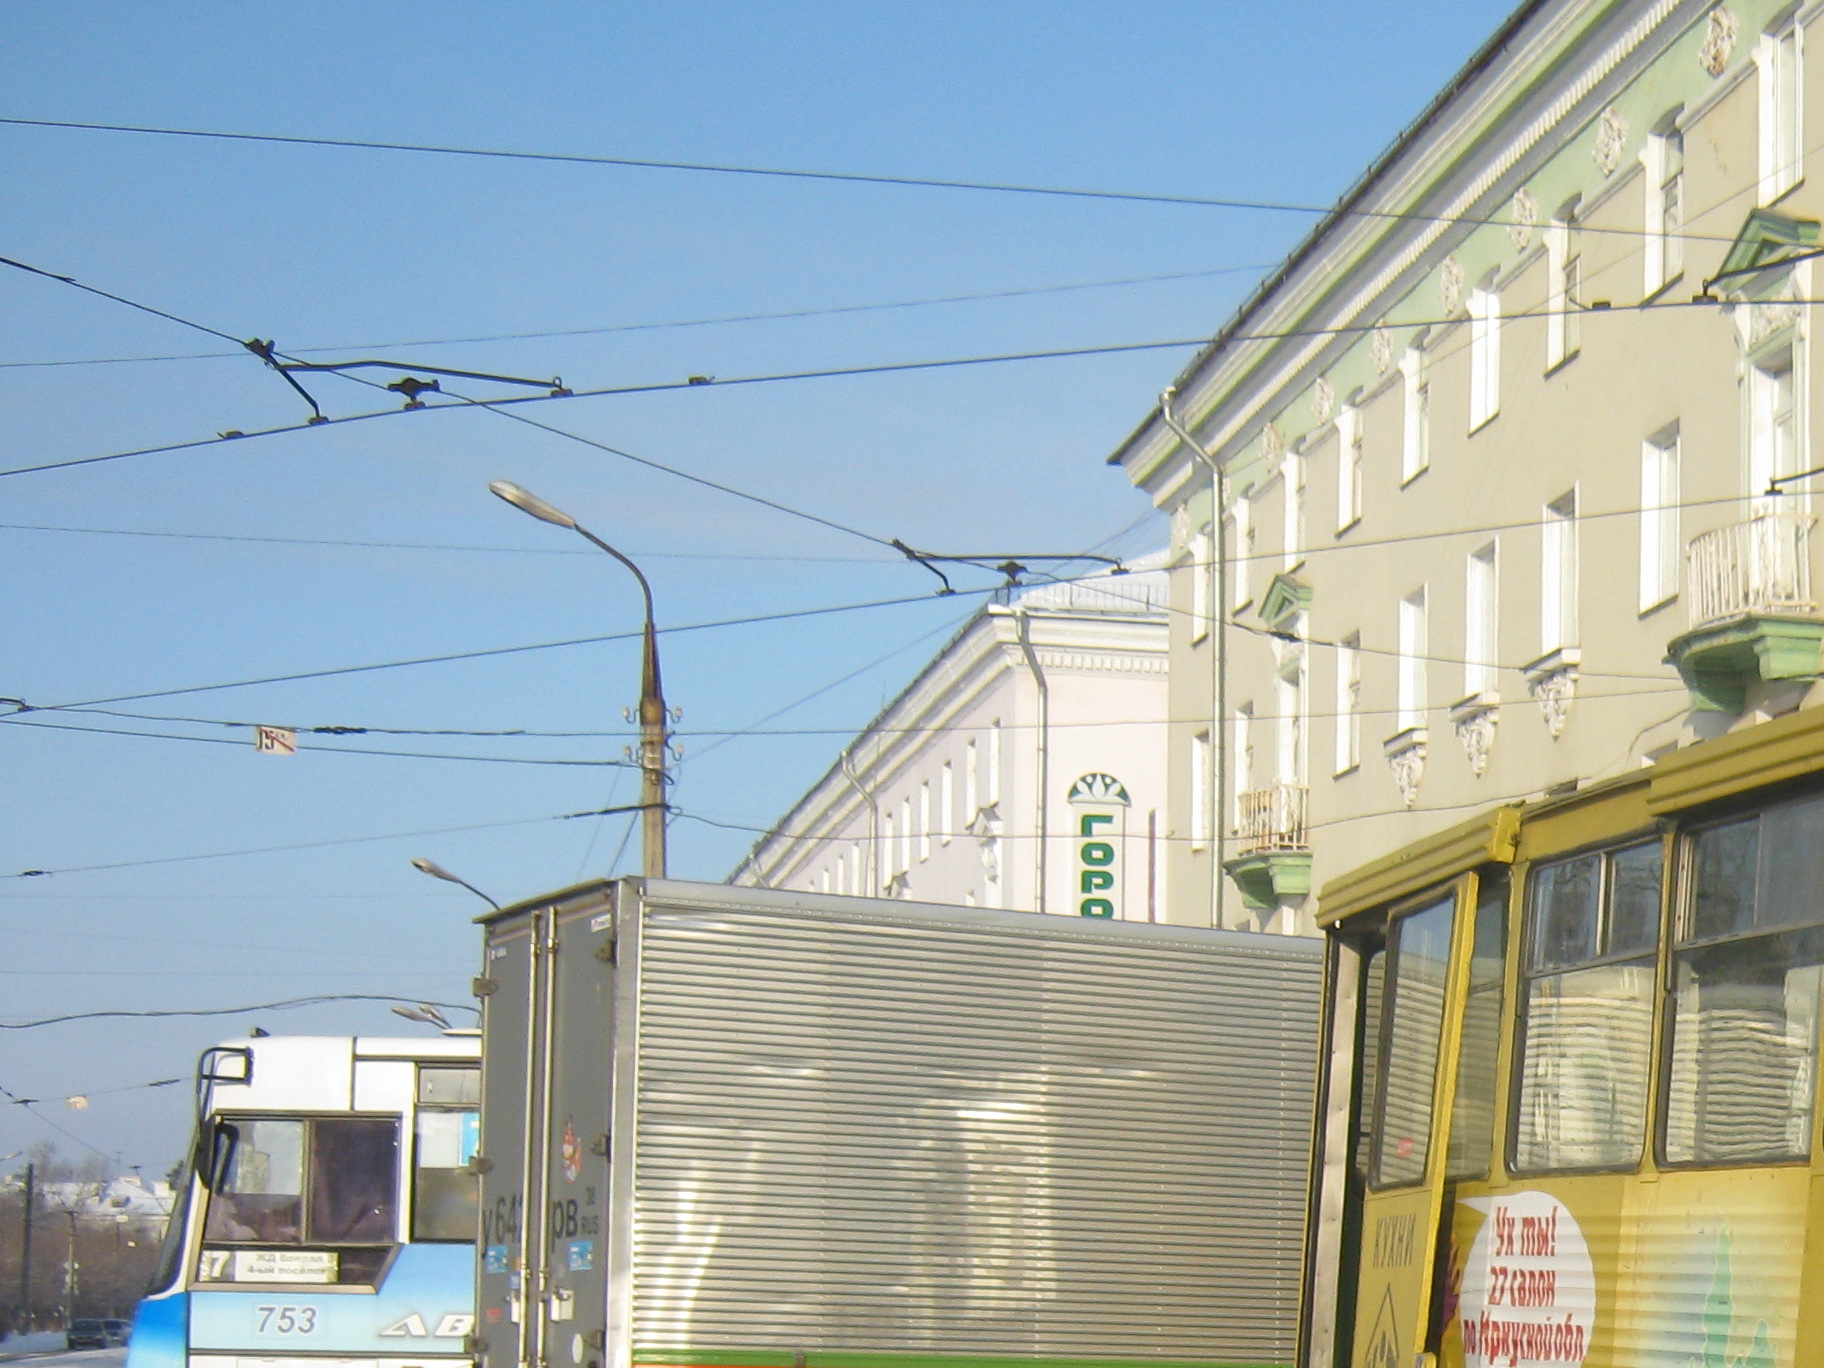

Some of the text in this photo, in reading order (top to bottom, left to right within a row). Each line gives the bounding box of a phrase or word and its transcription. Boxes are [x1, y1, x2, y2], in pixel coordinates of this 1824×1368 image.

[1509, 1268, 1557, 1307] салон
[257, 1306, 317, 1334] 753
[379, 1313, 475, 1338] АВ
